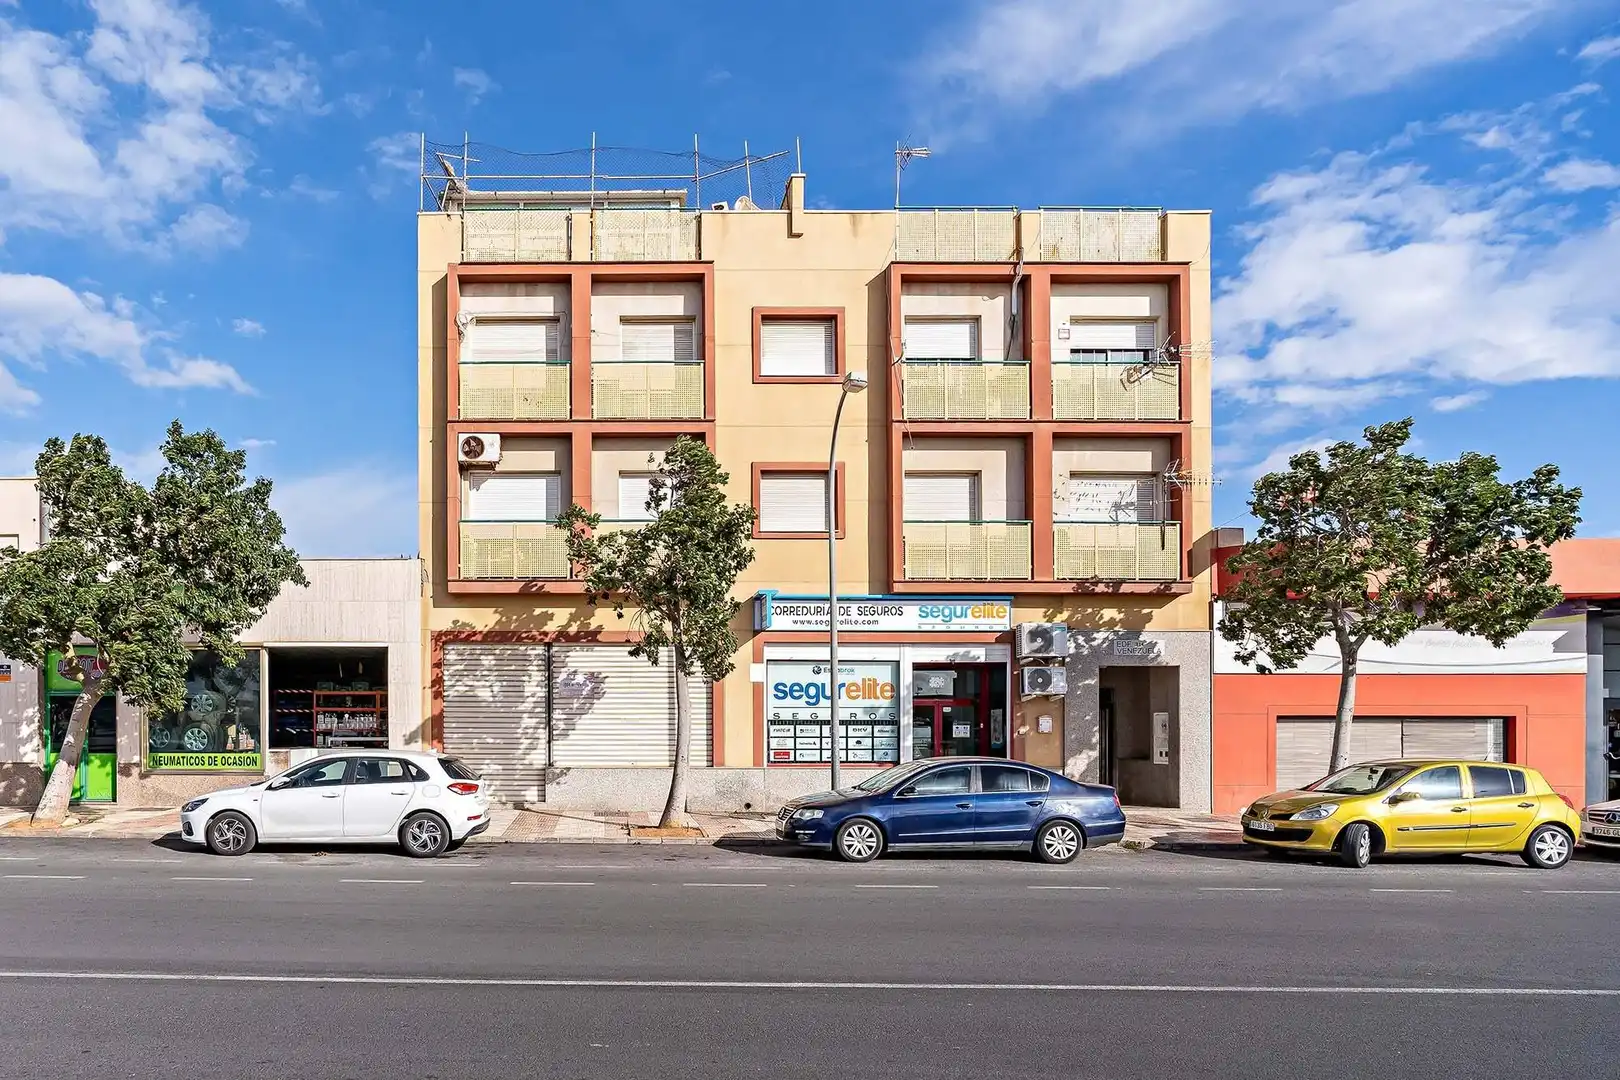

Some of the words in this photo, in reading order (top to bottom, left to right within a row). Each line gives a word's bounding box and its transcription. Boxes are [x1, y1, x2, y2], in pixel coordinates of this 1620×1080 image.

[838, 606, 851, 616] DE
[857, 606, 904, 617] SEGUROS
[918, 602, 1008, 623] segurelite
[773, 712, 896, 720] SEGROS
[152, 756, 206, 767] NEUMATICOS
[208, 756, 219, 767] DE
[220, 756, 258, 767] OCASION
